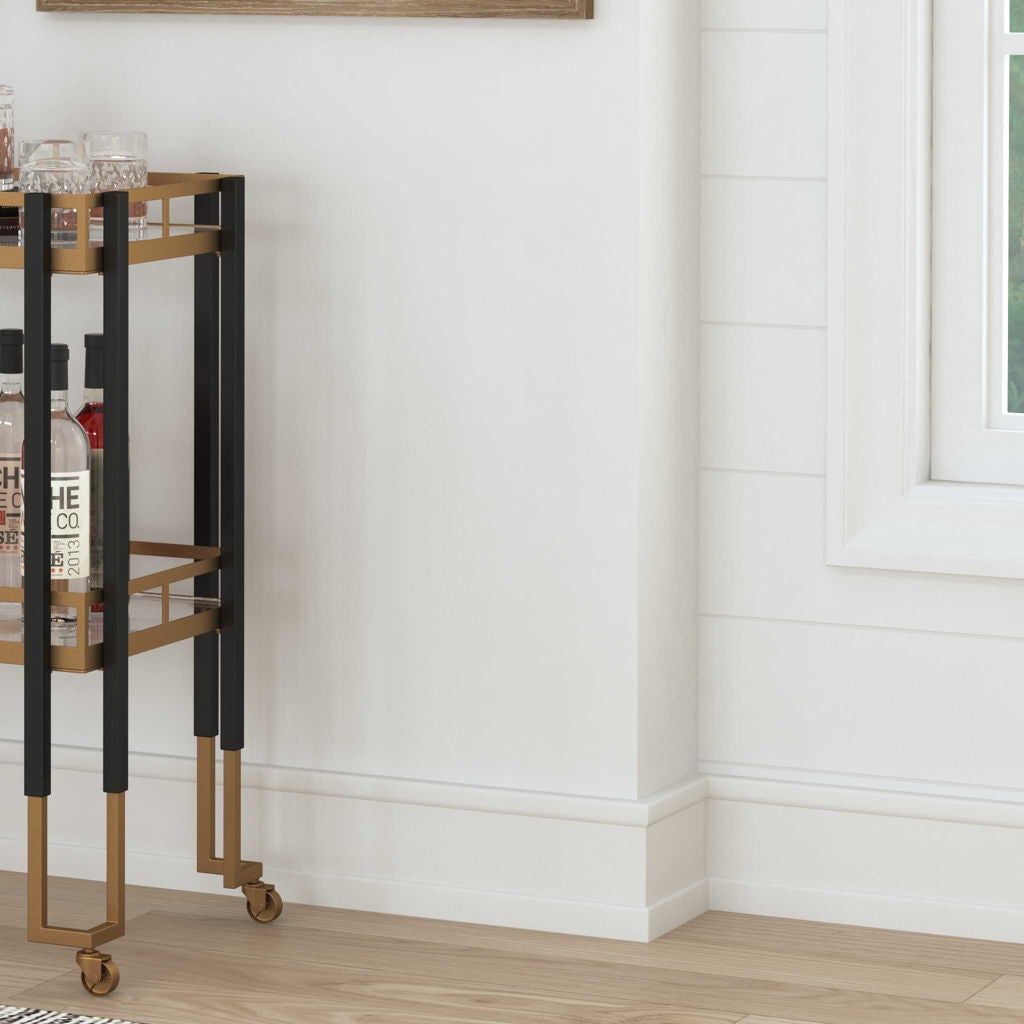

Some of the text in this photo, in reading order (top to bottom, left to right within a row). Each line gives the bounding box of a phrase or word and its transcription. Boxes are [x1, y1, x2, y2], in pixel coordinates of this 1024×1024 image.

[50, 485, 80, 509] HE
[56, 512, 80, 529] CO.
[67, 539, 80, 576] 2013
